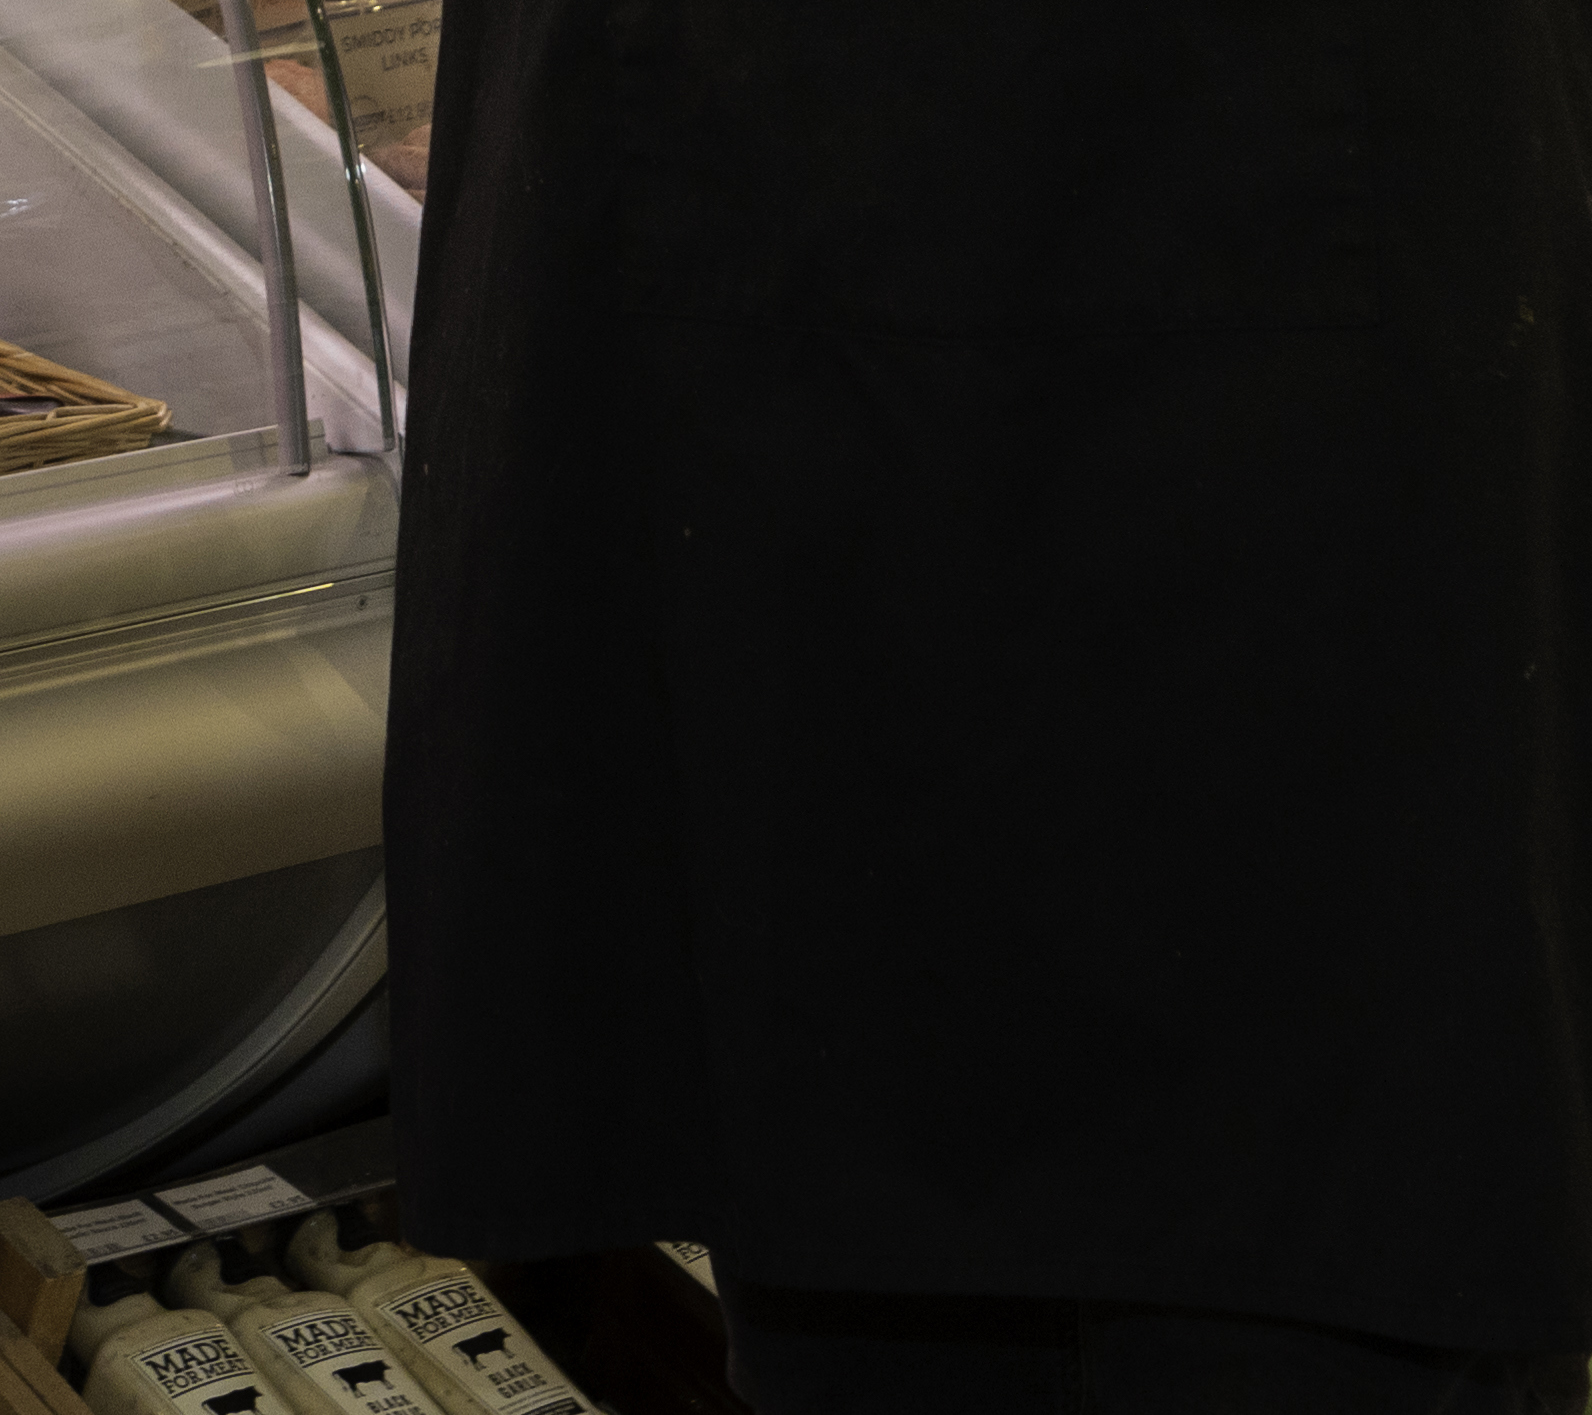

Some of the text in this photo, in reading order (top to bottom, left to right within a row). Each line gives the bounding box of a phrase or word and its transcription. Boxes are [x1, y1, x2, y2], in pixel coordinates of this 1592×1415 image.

[393, 1284, 487, 1328] MADE
[412, 1300, 498, 1342] FOR MEAT
[277, 1317, 362, 1353] MADE
[295, 1332, 383, 1365] FOR MEAT
[144, 1338, 239, 1381] MADE
[163, 1354, 255, 1395] FOR MEAT
[488, 1362, 530, 1385] BLACK
[368, 1393, 410, 1414] BLACK
[497, 1374, 547, 1398] GARLIC
